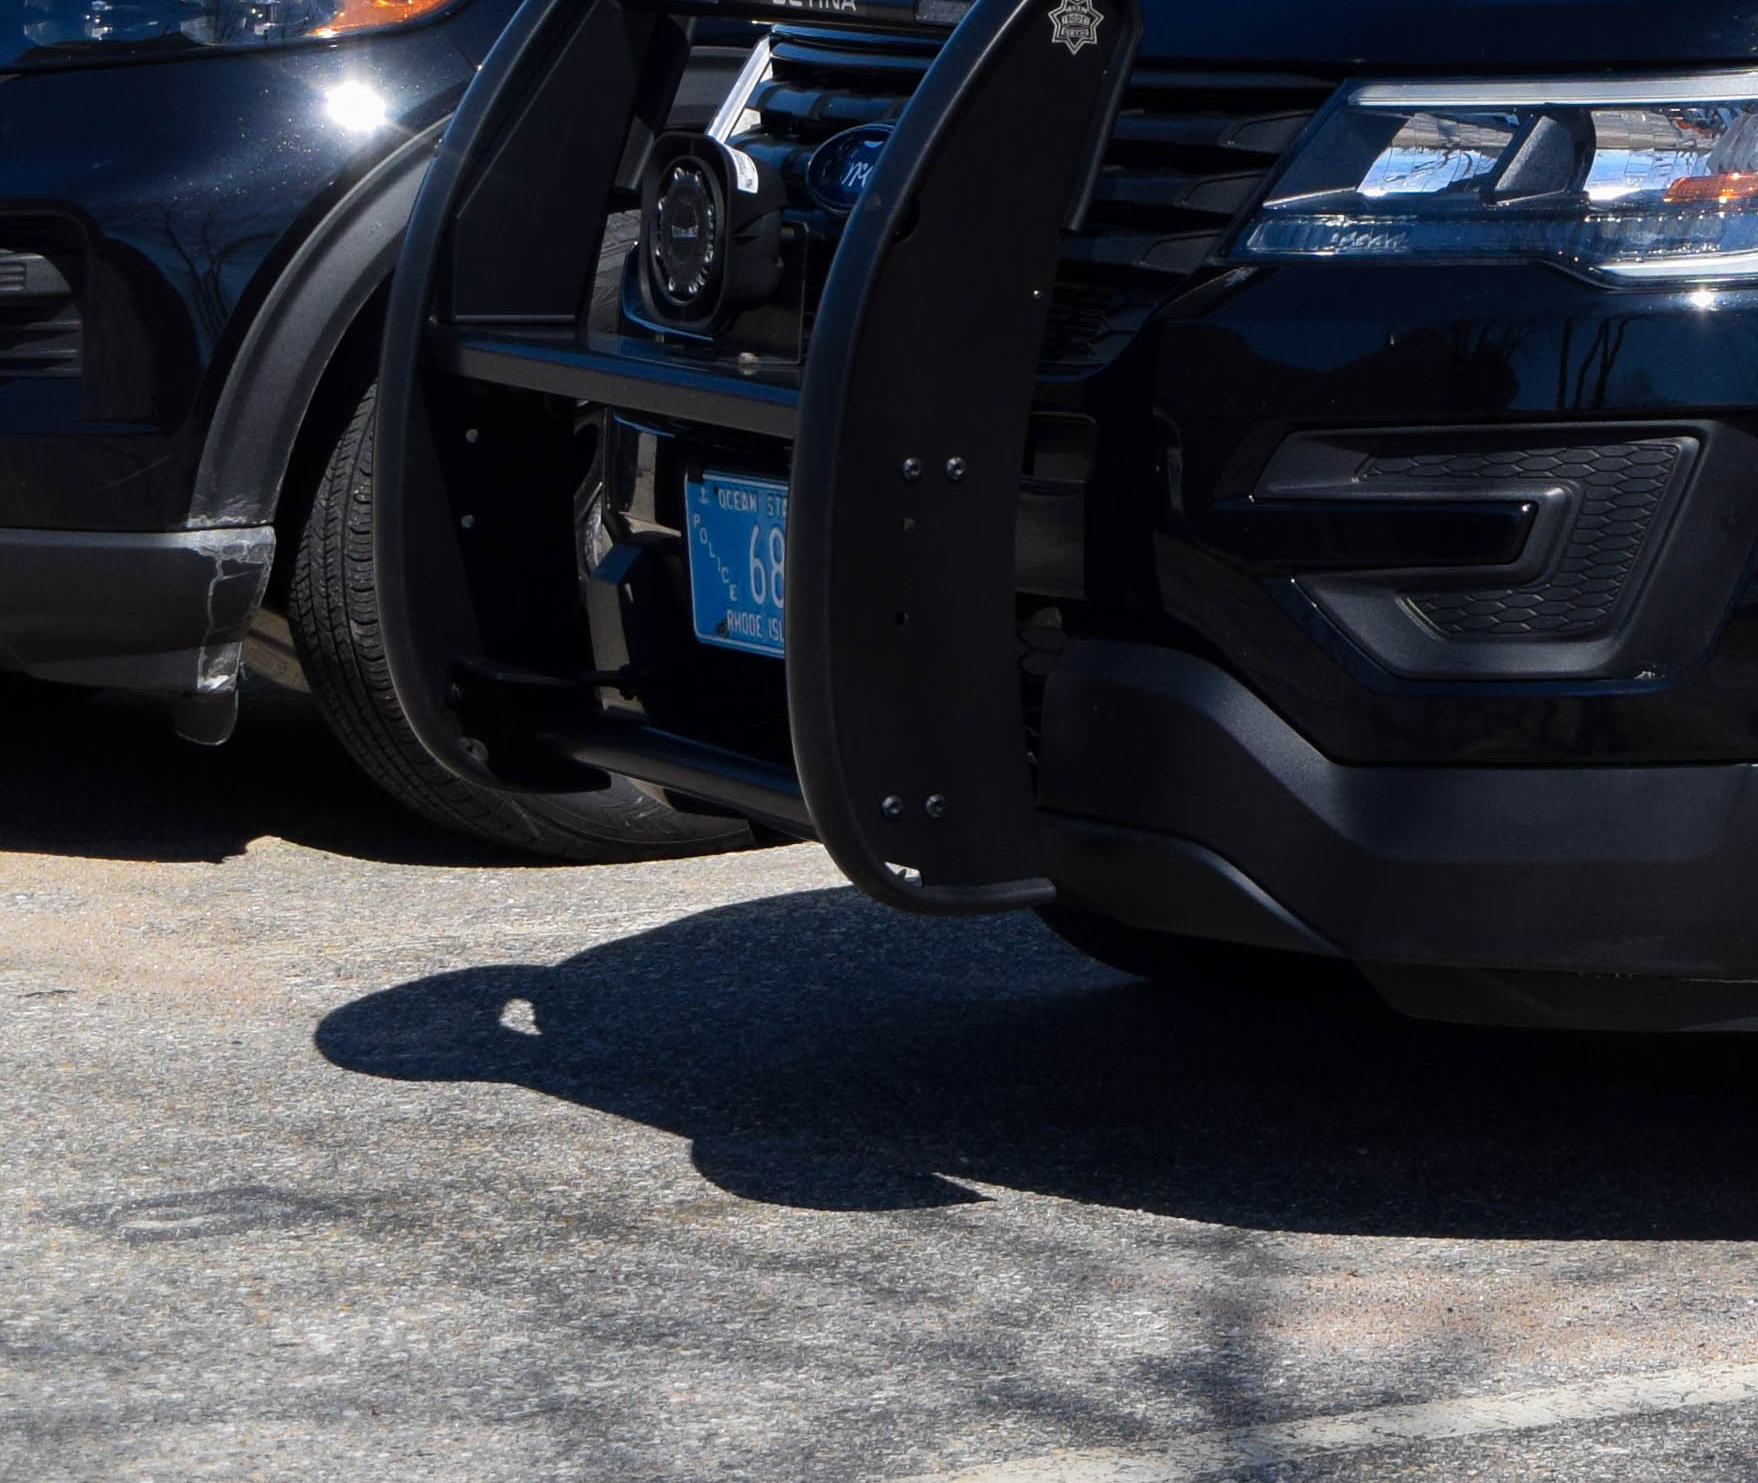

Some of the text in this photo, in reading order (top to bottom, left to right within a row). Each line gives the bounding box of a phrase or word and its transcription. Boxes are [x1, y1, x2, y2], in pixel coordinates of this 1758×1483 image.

[718, 488, 757, 512] OCEAN
[694, 514, 738, 602] POLICE
[750, 524, 785, 609] 68
[726, 609, 763, 639] RHODE
